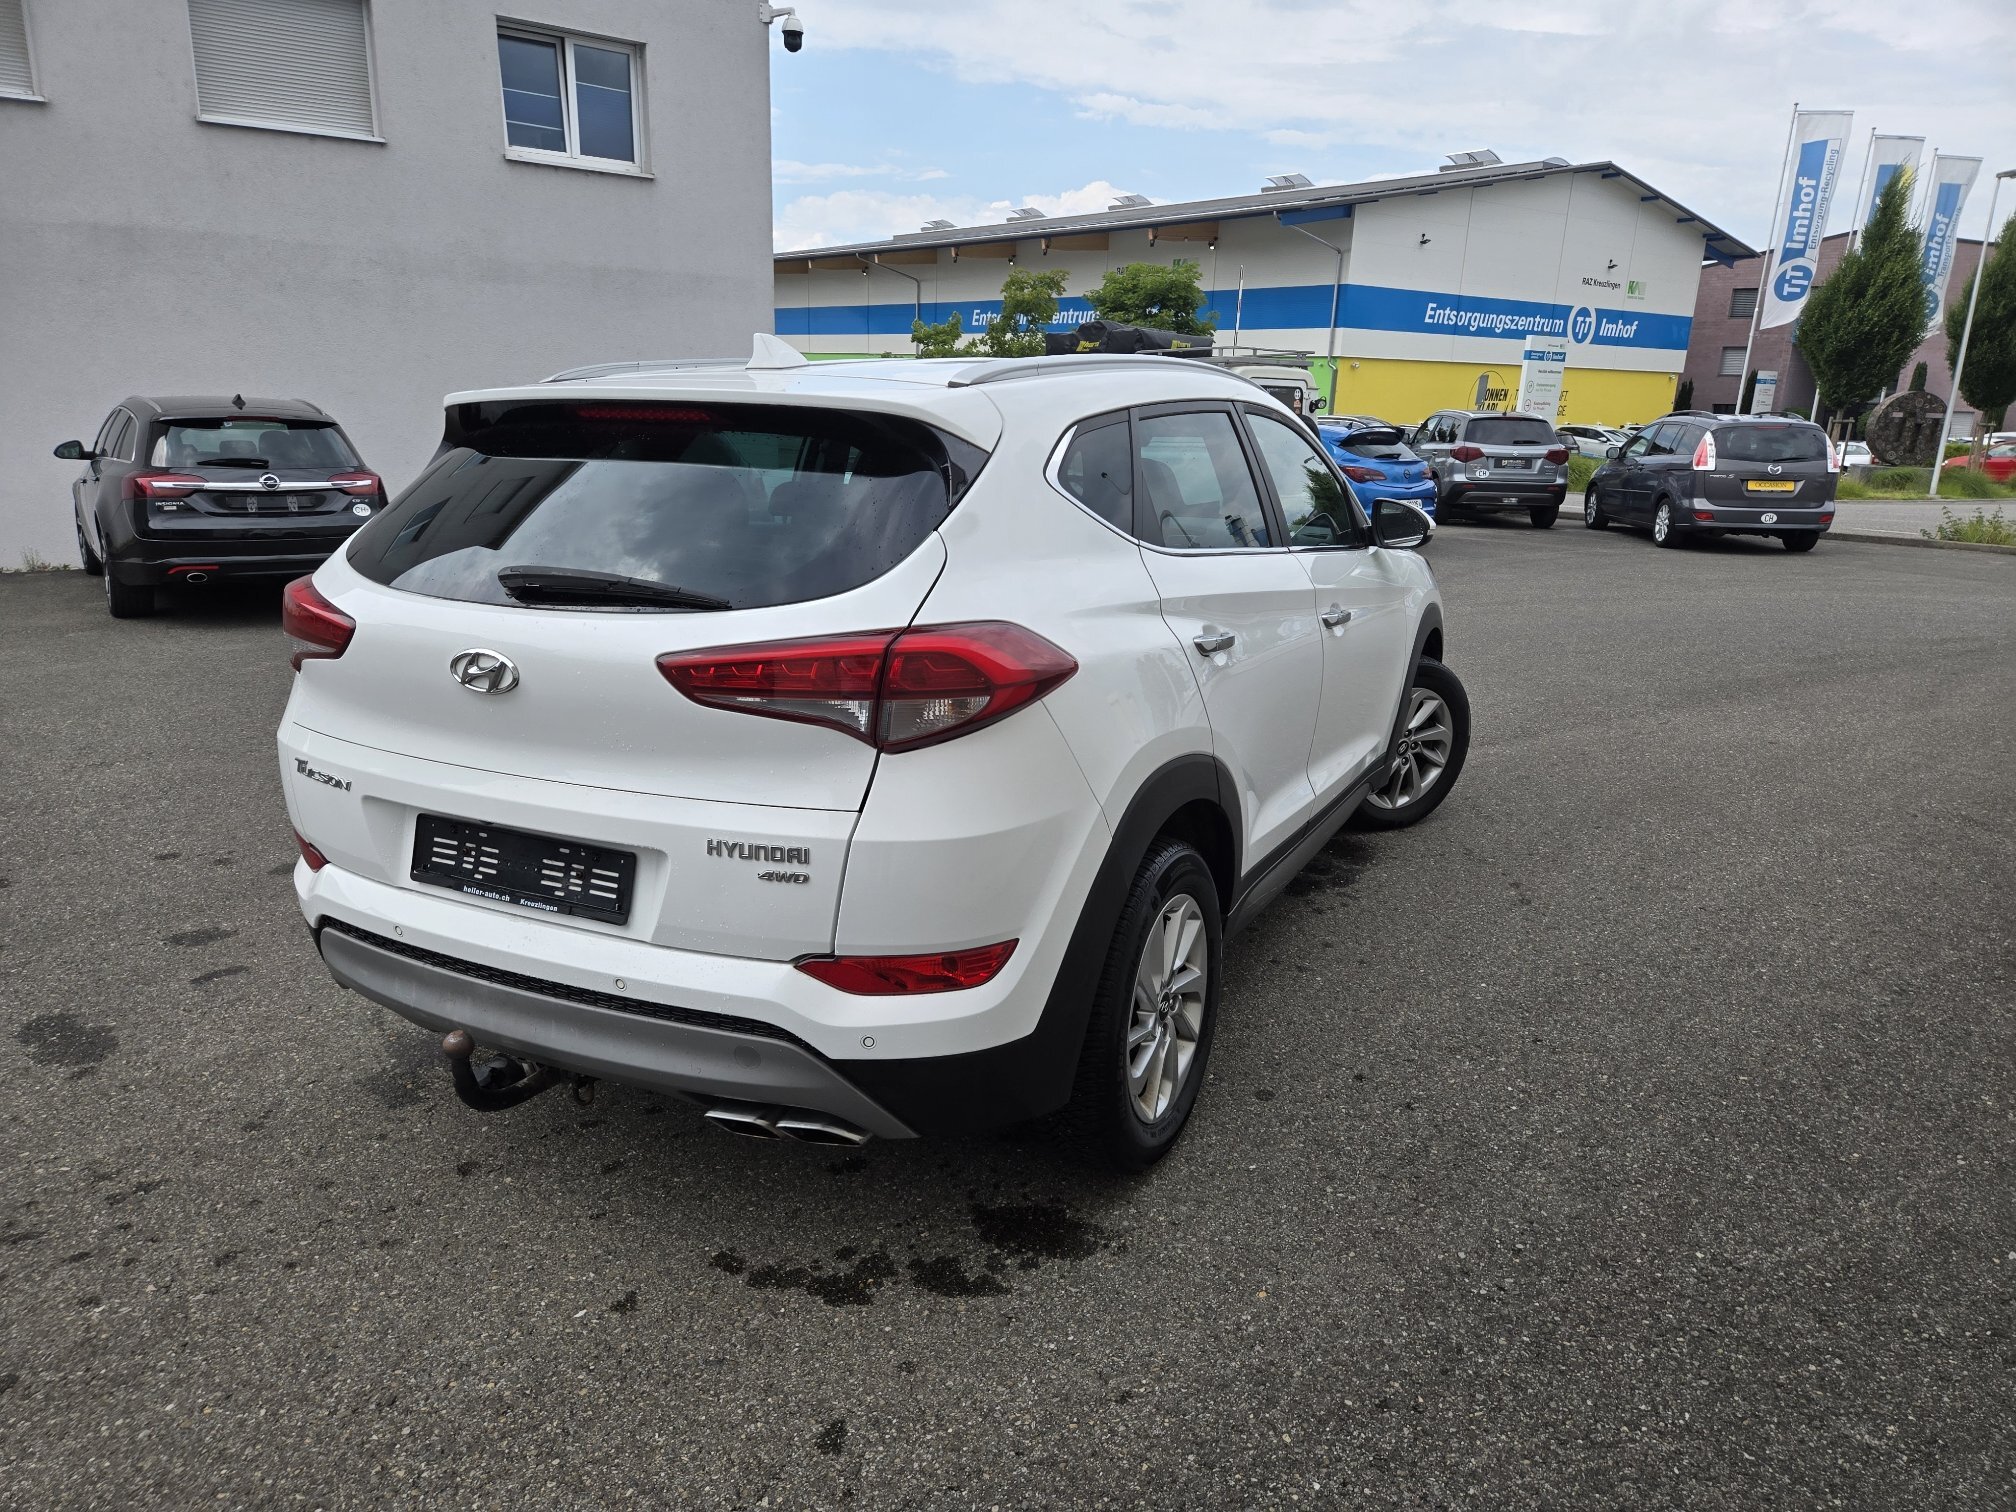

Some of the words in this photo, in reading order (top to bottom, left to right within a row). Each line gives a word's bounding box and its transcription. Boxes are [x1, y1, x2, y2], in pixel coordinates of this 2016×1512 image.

[1785, 176, 1817, 249] Imhof
[1424, 302, 1564, 333] Entsorgungszentrum
[1599, 317, 1638, 338] Imhof
[1478, 469, 1487, 477] CH
[1764, 514, 1774, 522] CH
[706, 838, 810, 865] HYUNDAI
[757, 869, 810, 884] 4WD
